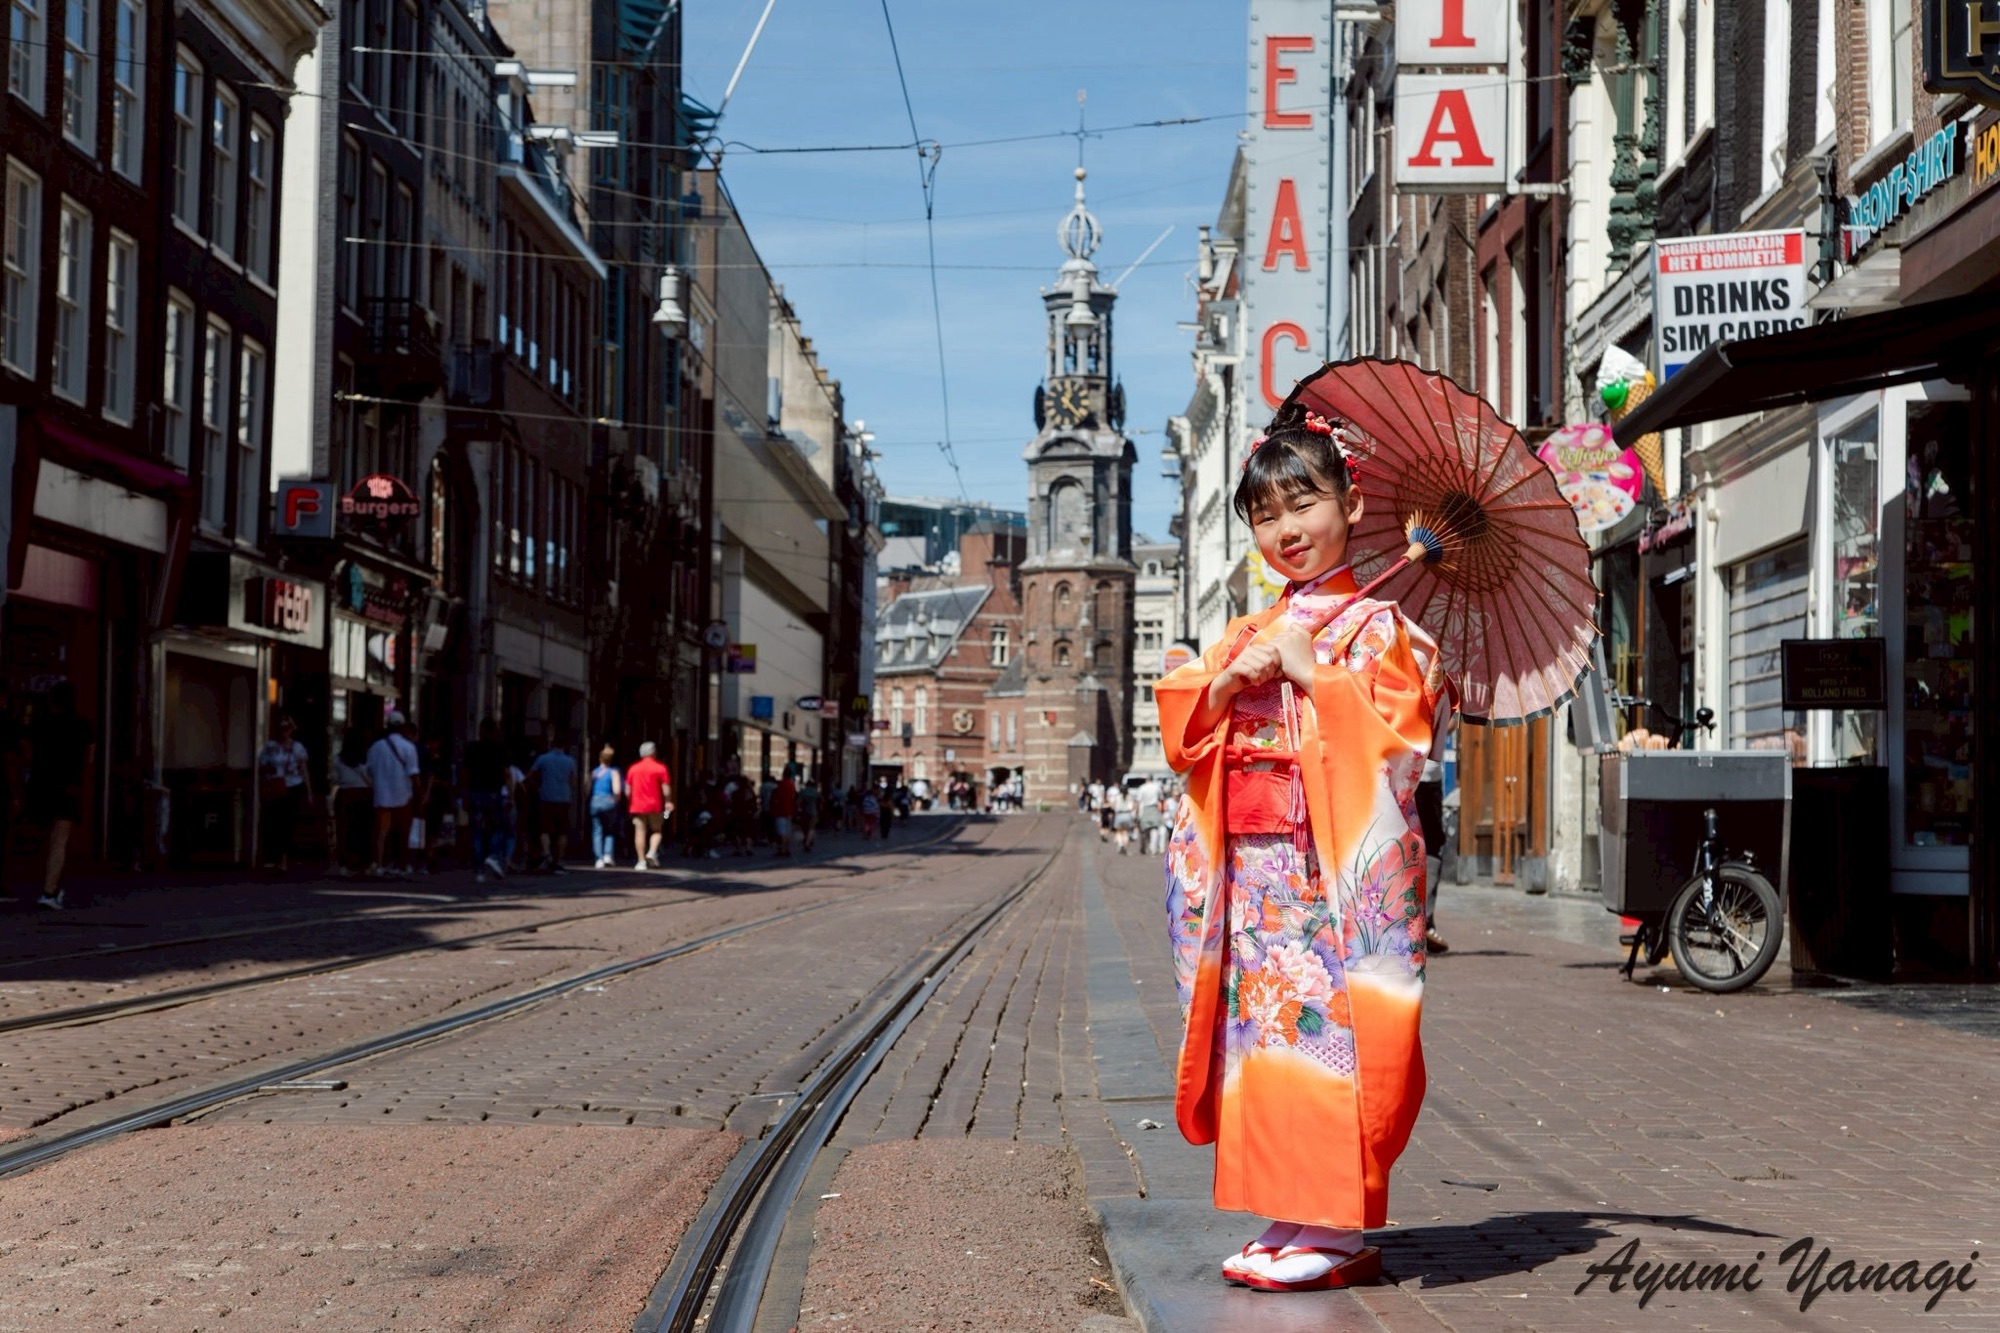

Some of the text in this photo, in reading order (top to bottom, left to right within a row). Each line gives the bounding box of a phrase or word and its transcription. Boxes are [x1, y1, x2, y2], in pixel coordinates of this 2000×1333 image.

[1976, 121, 2000, 187] HO
[1668, 249, 1786, 272] HET BOMMETJE
[1674, 278, 1790, 316] DRINKS
[1663, 324, 1710, 353] SIM
[285, 488, 320, 528] F
[342, 497, 419, 519] Burgers
[274, 578, 312, 632] FEBO
[1801, 687, 1840, 698] HOLLAND
